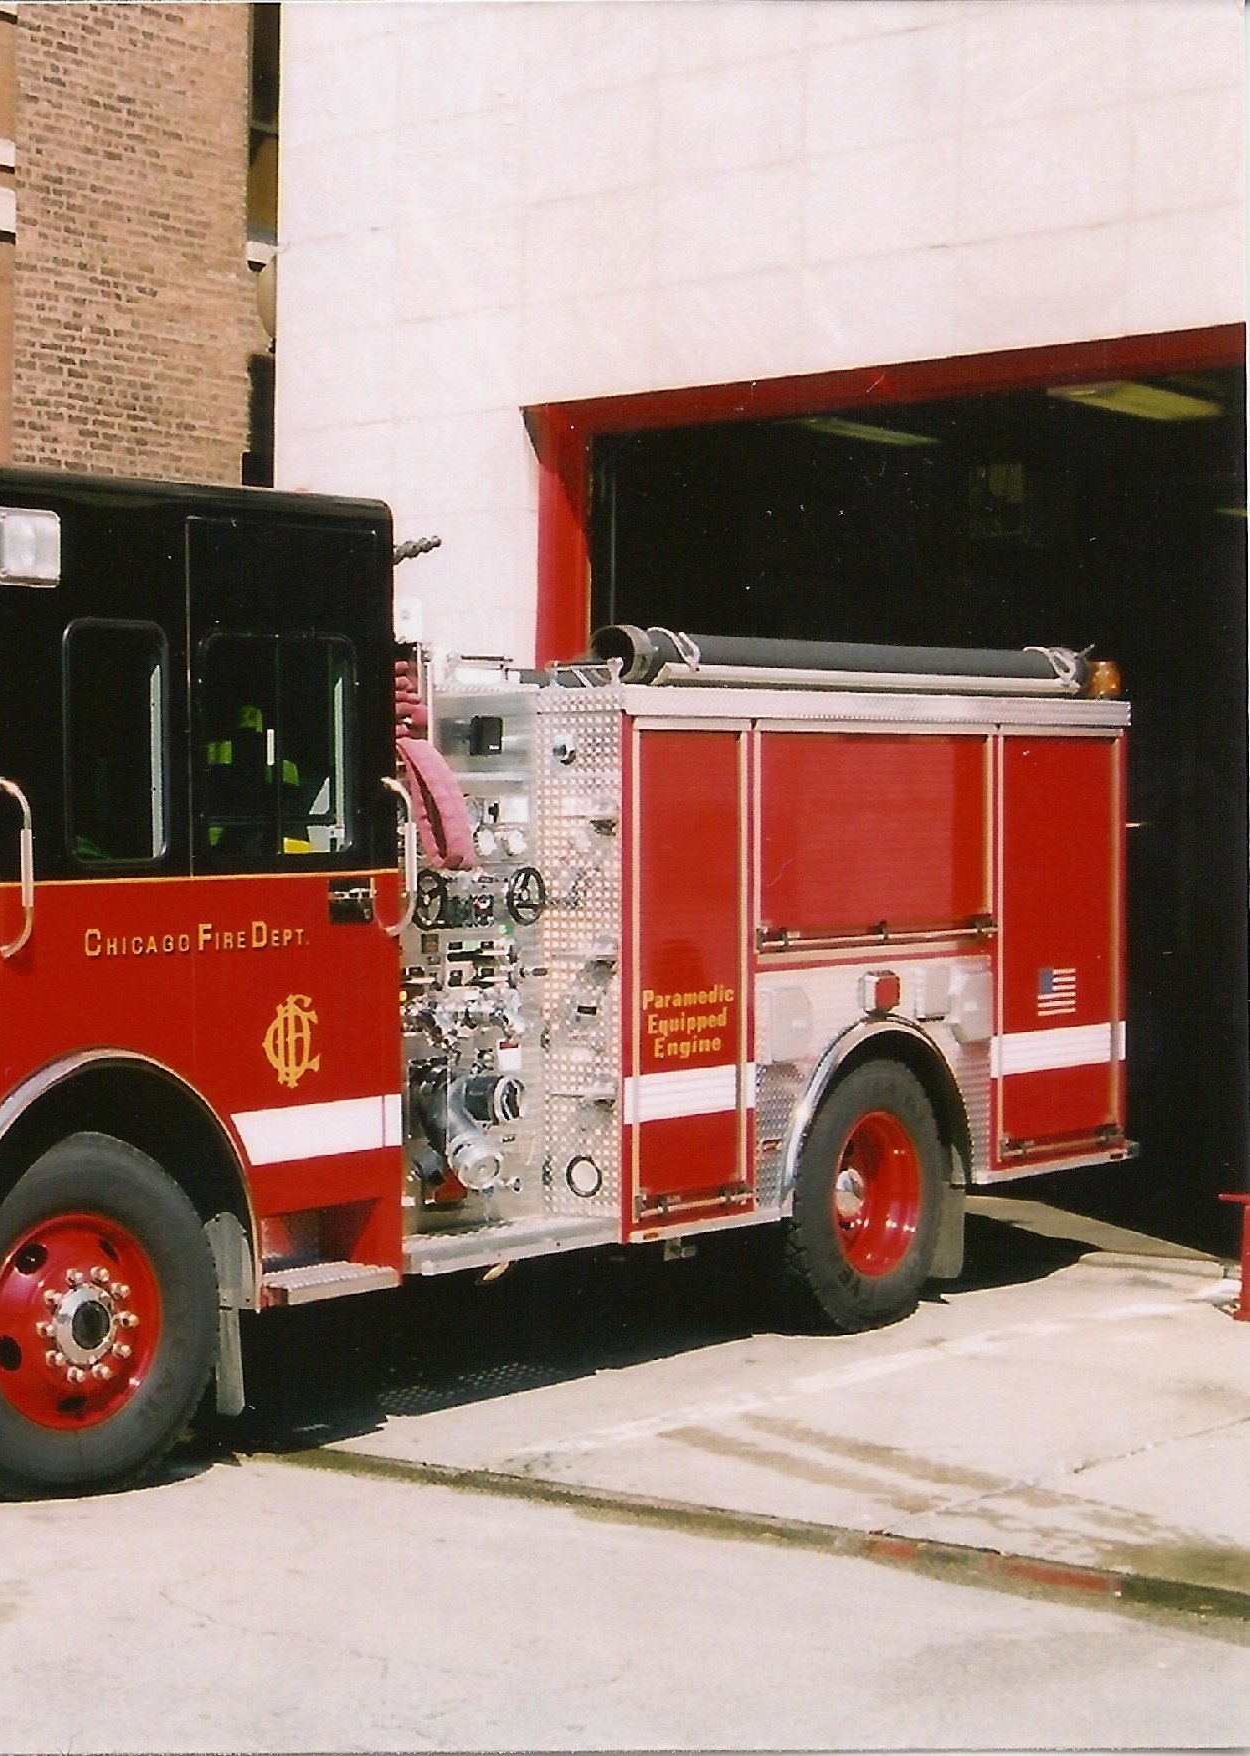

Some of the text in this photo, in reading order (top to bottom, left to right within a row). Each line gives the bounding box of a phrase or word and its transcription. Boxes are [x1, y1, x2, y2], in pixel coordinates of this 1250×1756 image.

[84, 920, 310, 957] CHICAGO FIRE DEPT.
[642, 983, 735, 1010] Paramedic
[647, 1006, 728, 1037] Equipped
[653, 1035, 722, 1059] Engine
